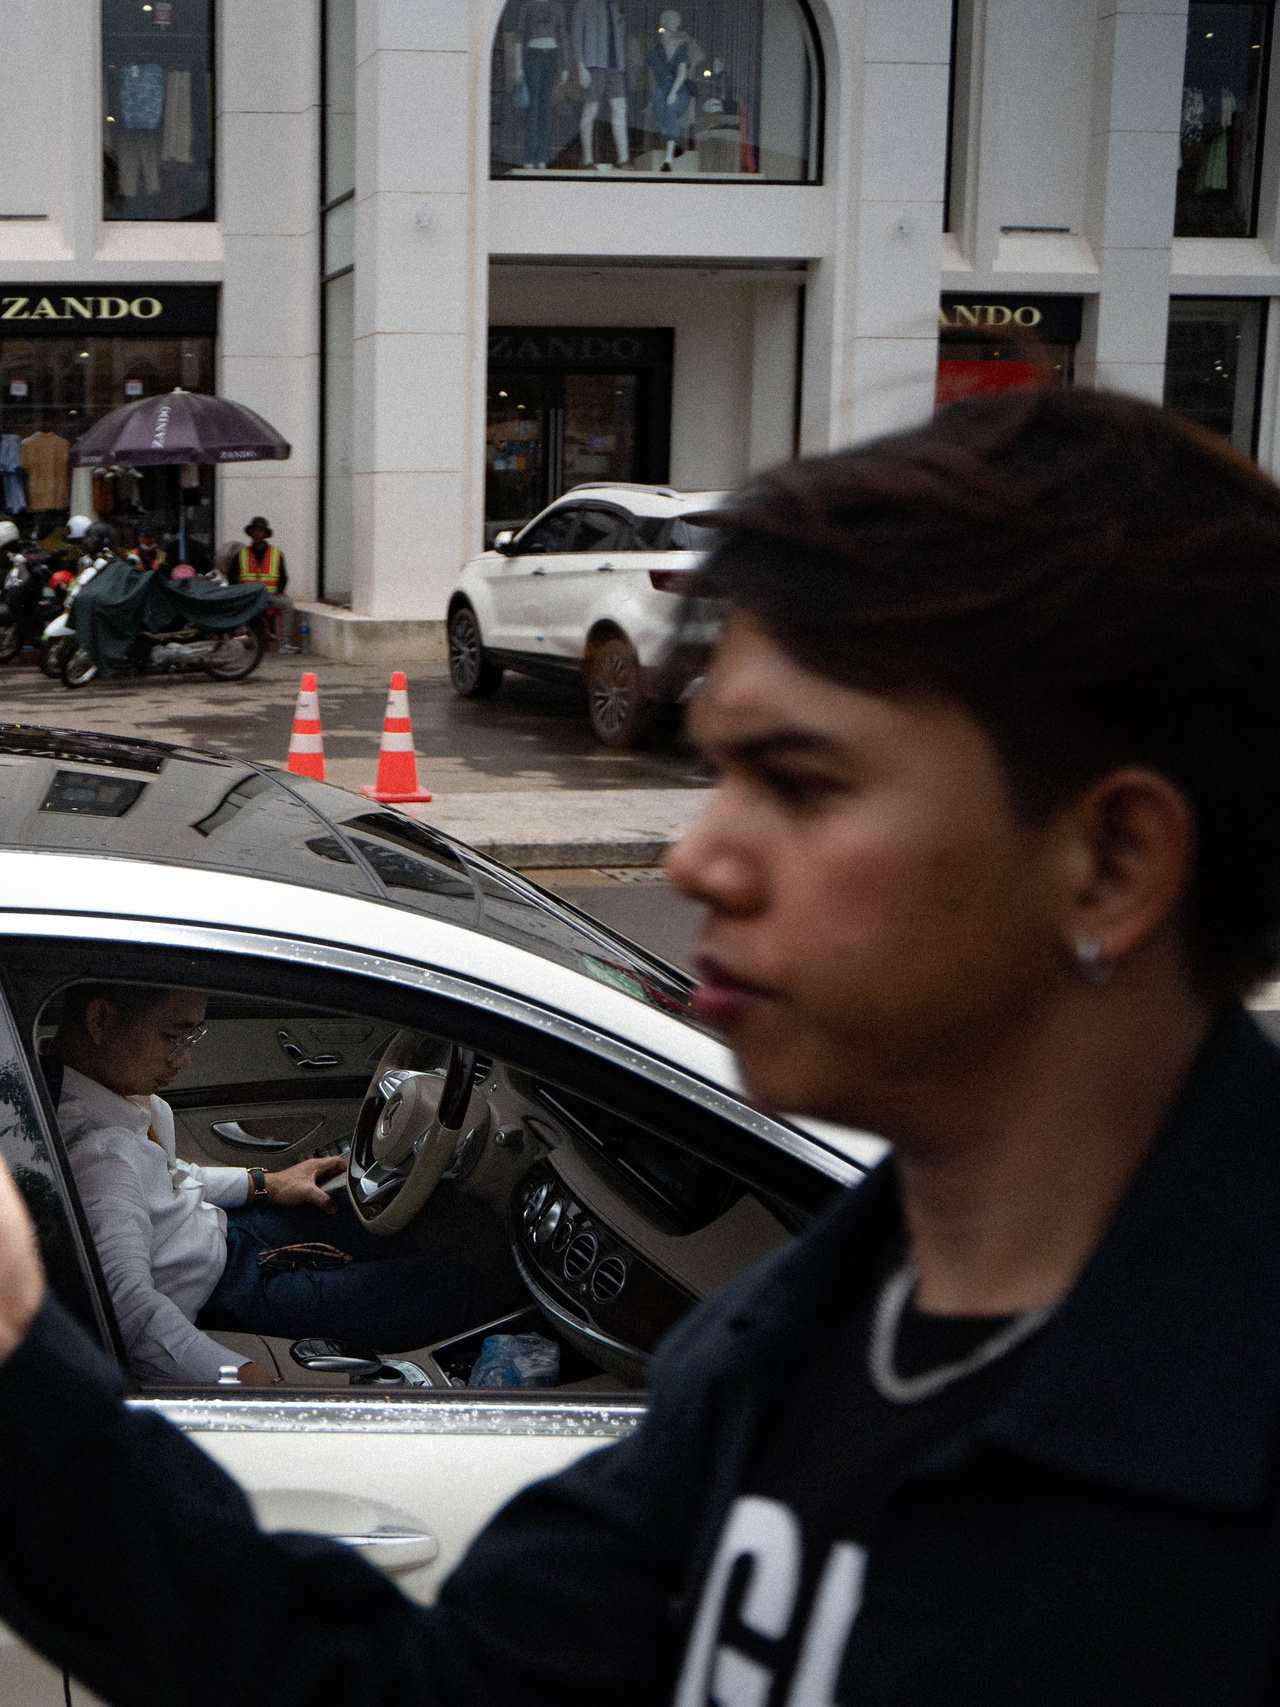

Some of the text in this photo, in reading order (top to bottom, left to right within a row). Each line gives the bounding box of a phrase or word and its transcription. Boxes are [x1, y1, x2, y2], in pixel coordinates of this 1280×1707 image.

[1, 297, 163, 319] ZANDO
[939, 305, 1042, 327] ANDO
[490, 335, 642, 359] ZANDO
